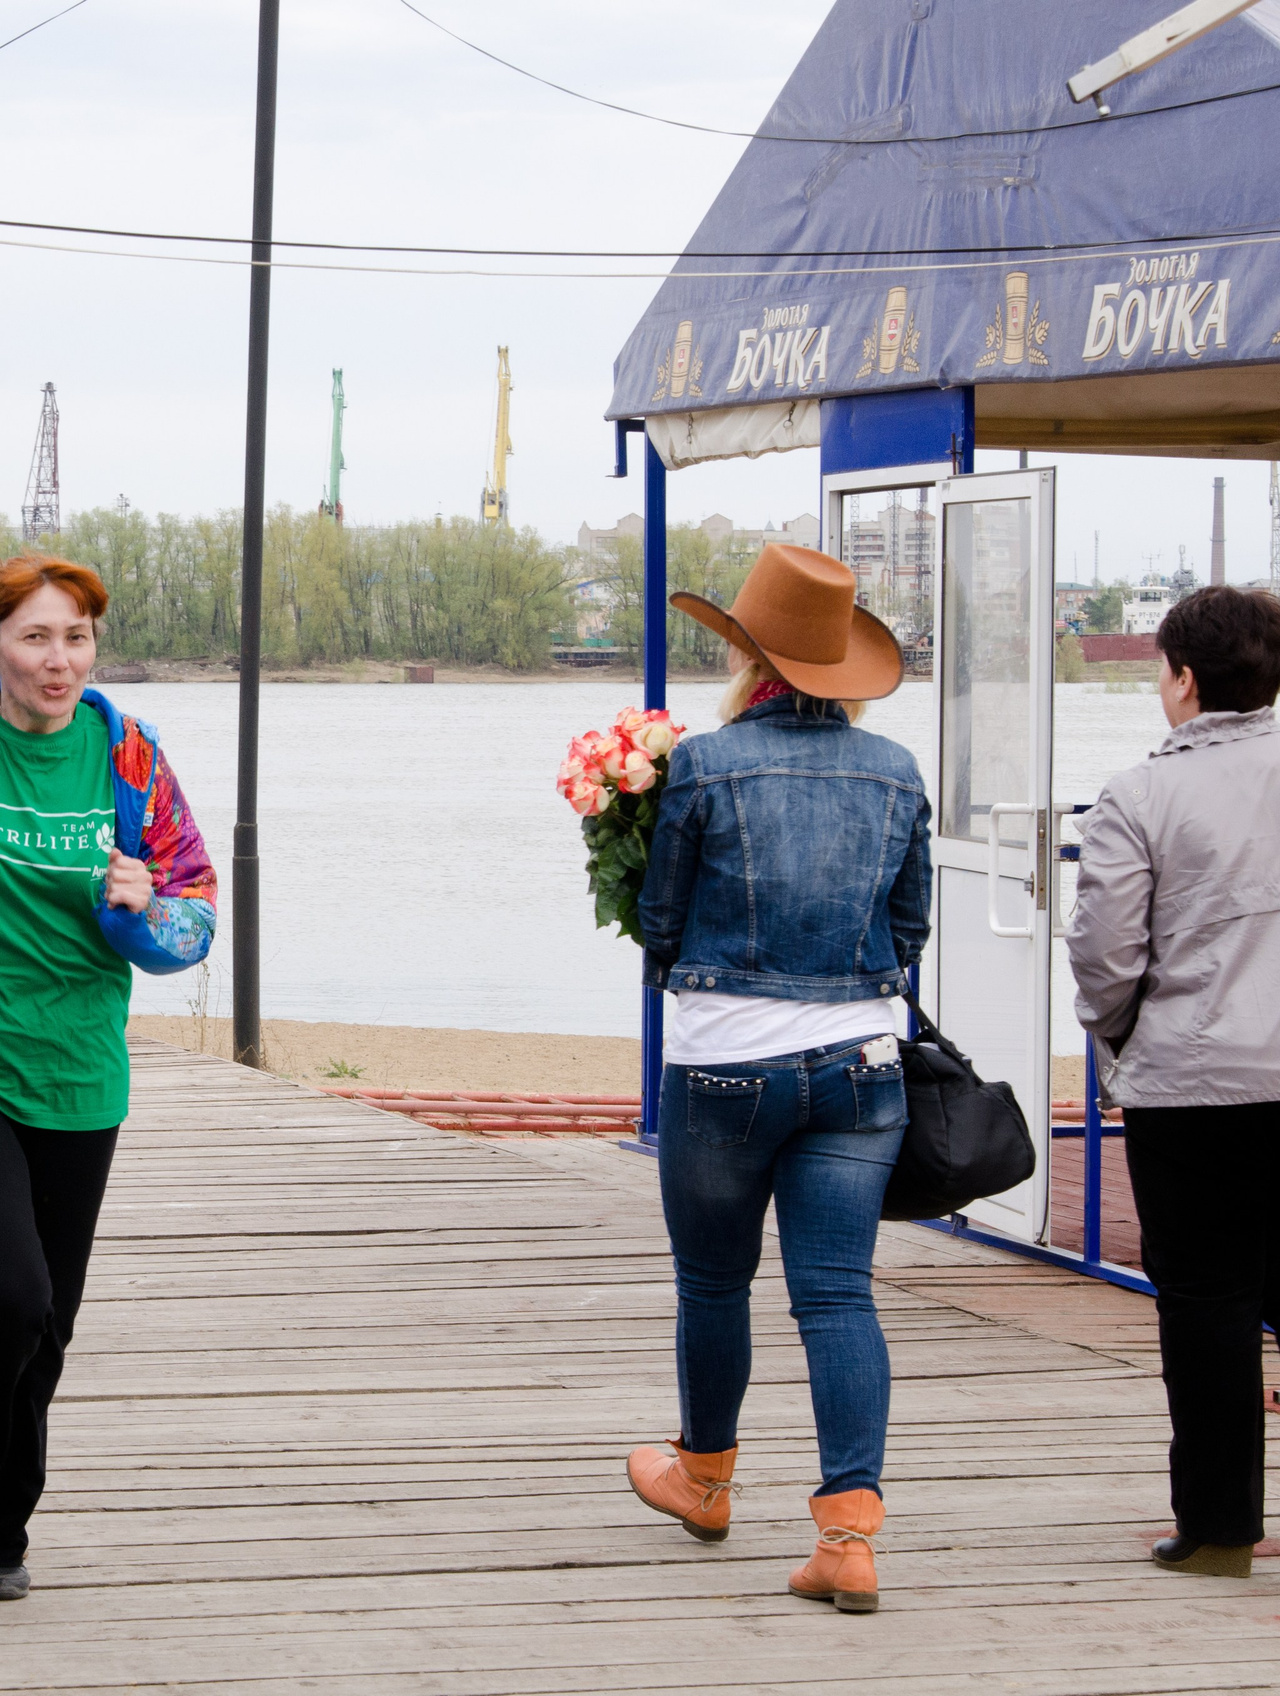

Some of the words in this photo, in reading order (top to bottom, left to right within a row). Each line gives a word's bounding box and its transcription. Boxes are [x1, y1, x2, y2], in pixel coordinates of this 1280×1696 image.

[1125, 252, 1200, 287] ЗОЛОТАЯ
[761, 303, 809, 332] ЗОЛОТАЯ
[1082, 278, 1231, 361] БОЧКА
[726, 325, 831, 393] БОЧКА
[62, 821, 95, 833] TEAM
